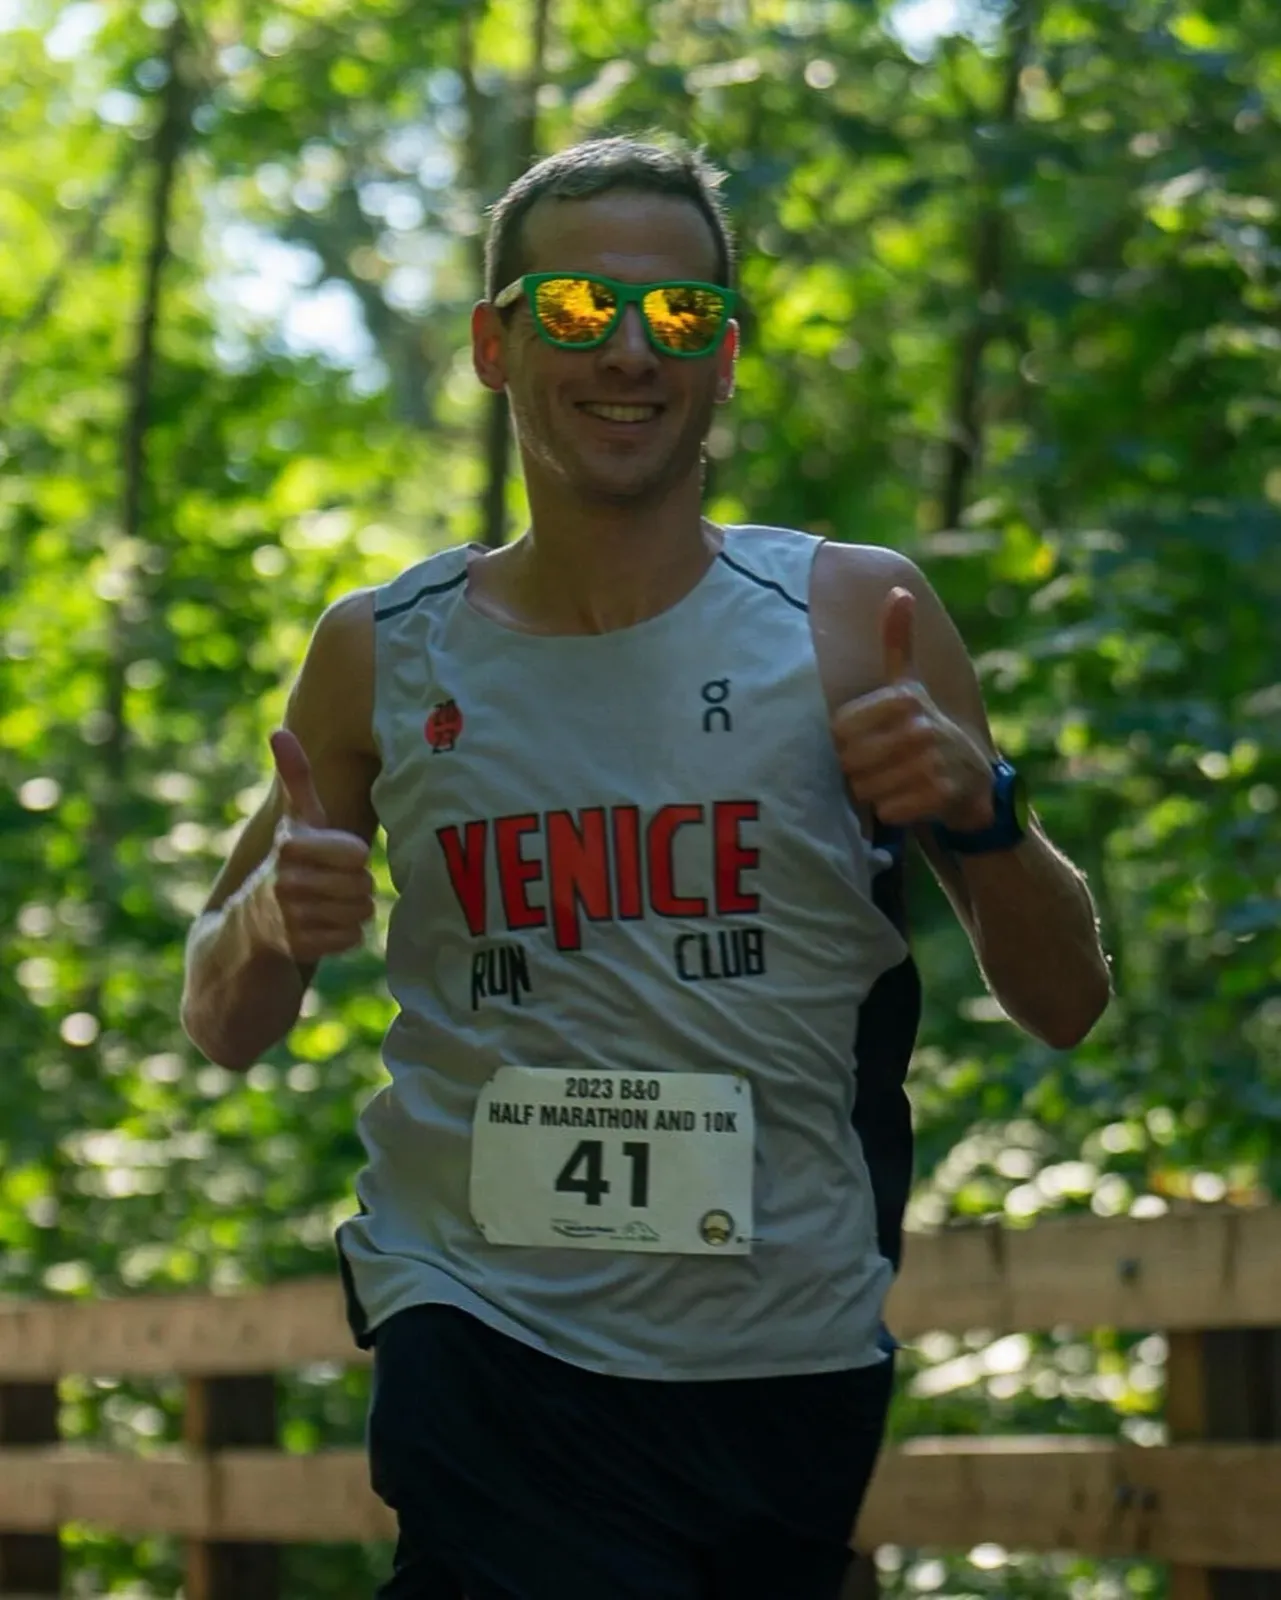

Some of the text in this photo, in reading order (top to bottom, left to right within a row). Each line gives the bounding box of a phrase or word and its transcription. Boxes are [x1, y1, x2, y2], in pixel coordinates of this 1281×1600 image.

[436, 800, 761, 951] VENICE
[471, 929, 766, 1011] RUN CLUB
[489, 1102, 738, 1133] HALF MARATHON AND 10K
[565, 1077, 661, 1101] 2023 B&O
[554, 1139, 651, 1208] 41
